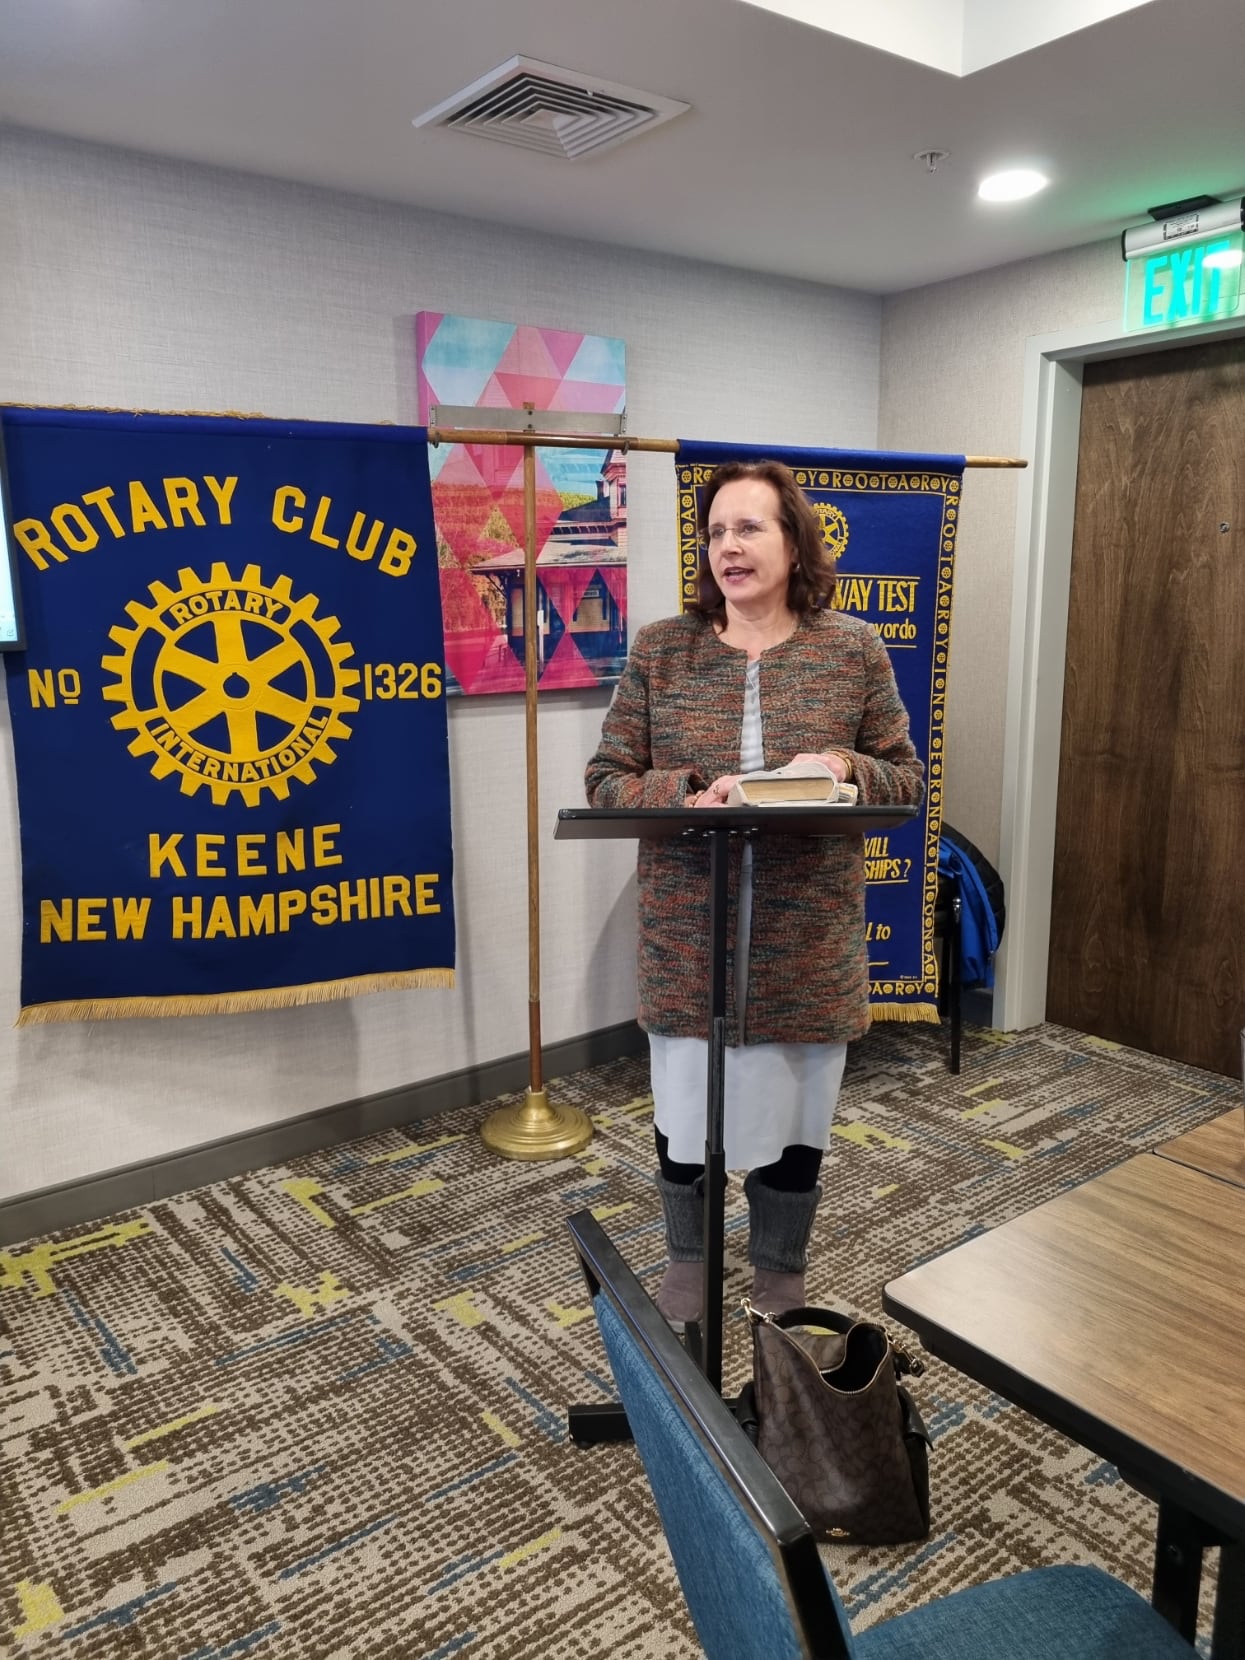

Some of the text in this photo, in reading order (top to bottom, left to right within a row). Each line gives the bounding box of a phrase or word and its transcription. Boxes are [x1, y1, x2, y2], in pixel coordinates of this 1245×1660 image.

[1143, 240, 1230, 326] EXIT
[13, 476, 418, 577] ROTARY CLUB
[169, 590, 283, 625] ROTARY
[831, 578, 919, 613] WAY TEST
[364, 662, 442, 700] 1326
[151, 716, 329, 782] INTERNATIONAL
[149, 823, 343, 878] KEENE
[40, 873, 441, 943] NEW HAMPSHIRE
